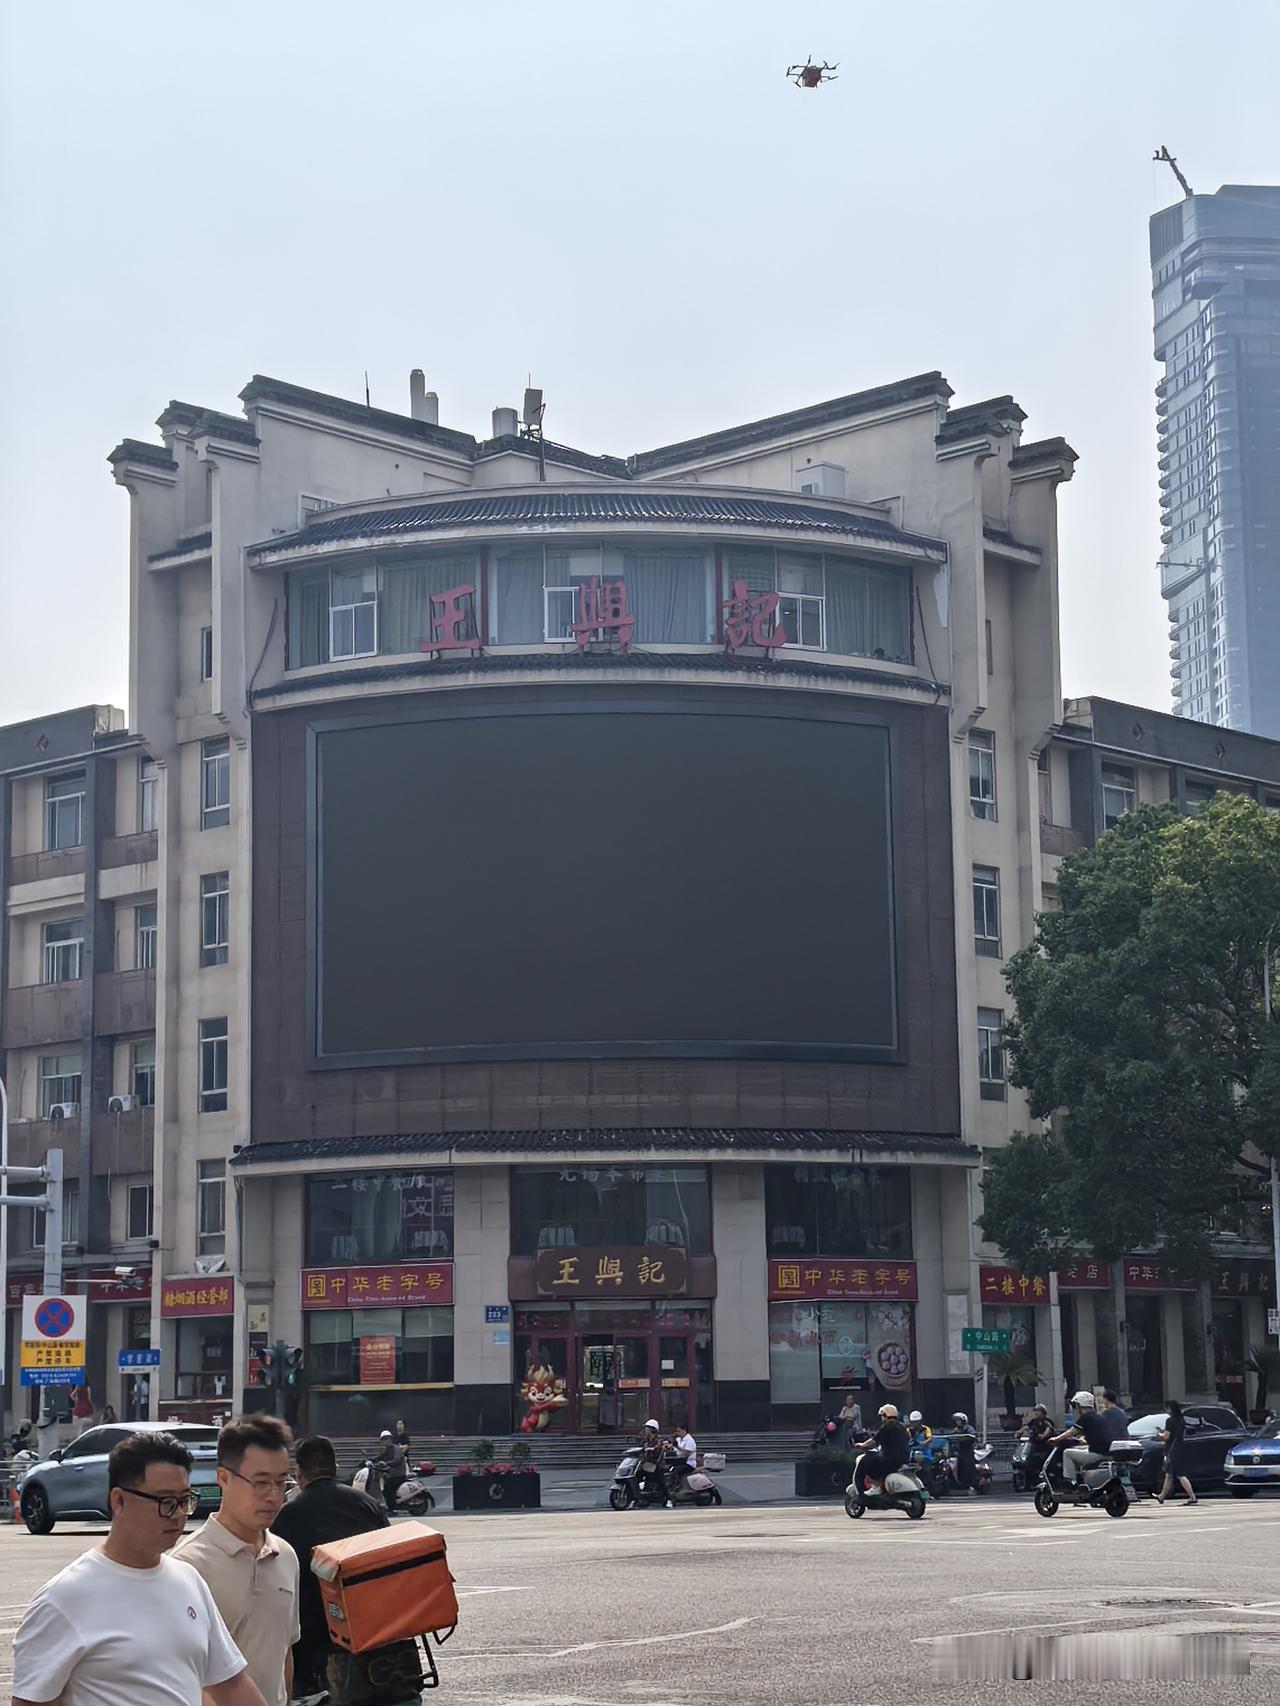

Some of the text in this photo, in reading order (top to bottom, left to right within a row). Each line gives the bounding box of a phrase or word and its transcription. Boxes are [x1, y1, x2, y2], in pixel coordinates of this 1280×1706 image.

[330, 1272, 446, 1293] 中华老字号
[804, 1268, 911, 1286] 中华老字号
